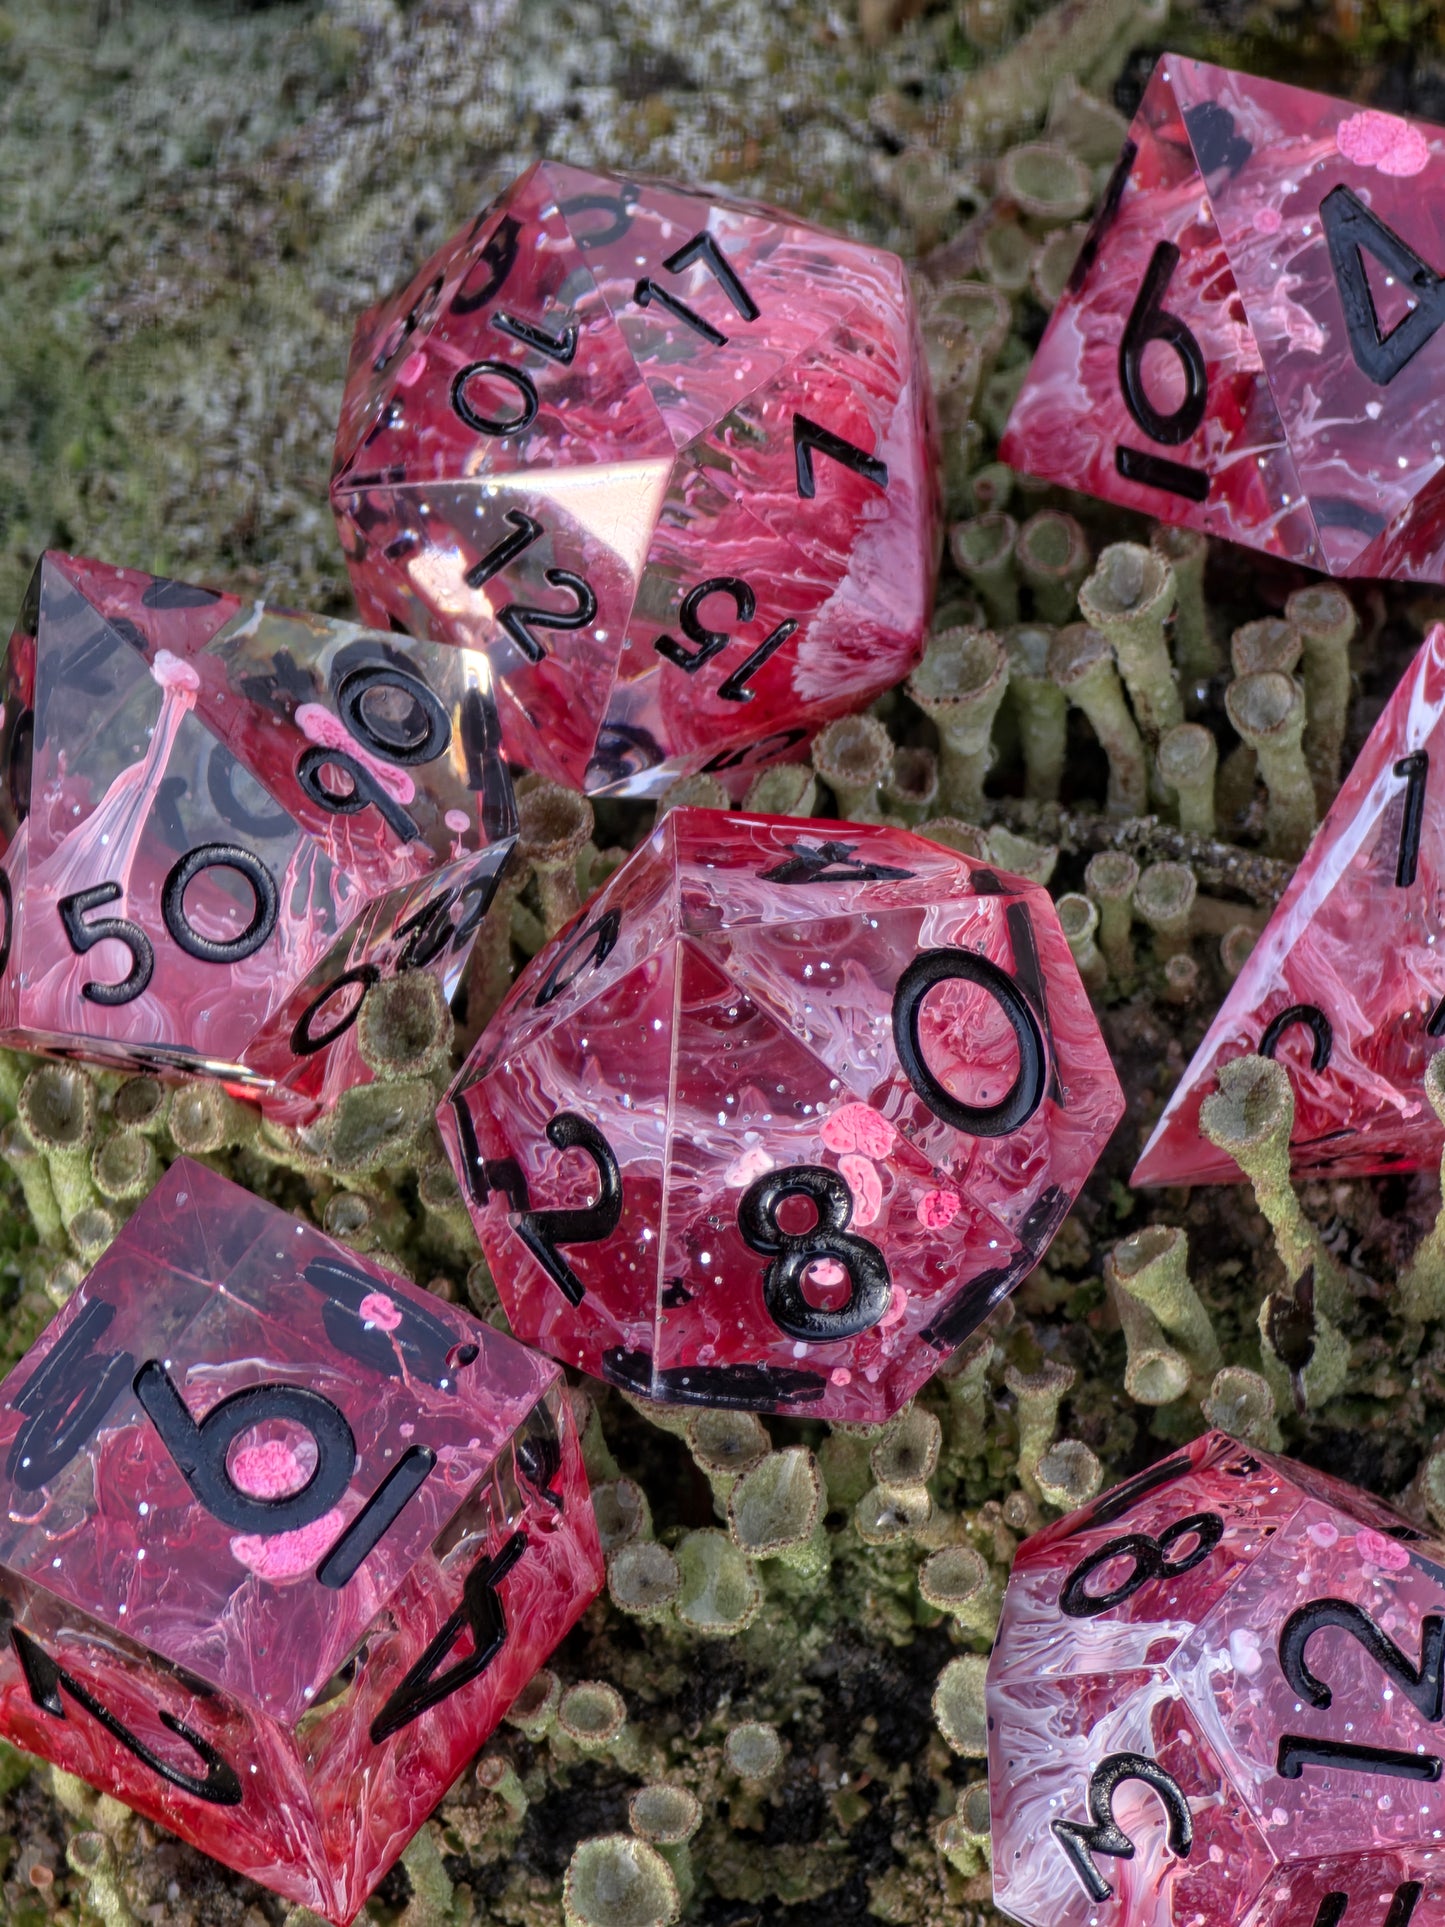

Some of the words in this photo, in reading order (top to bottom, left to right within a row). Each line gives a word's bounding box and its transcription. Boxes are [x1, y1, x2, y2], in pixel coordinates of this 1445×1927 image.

[633, 229, 761, 347] 17
[1119, 240, 1208, 446] 6
[450, 311, 579, 437] 10
[792, 411, 889, 499] 7
[464, 507, 598, 664] 12
[653, 576, 798, 702] 15
[298, 665, 454, 844] 90
[1394, 749, 1429, 888] 1
[58, 842, 281, 1006] 50
[891, 947, 1049, 1138] 0
[737, 1164, 892, 1343] 8
[369, 1531, 528, 1745] 4
[1059, 1512, 1225, 1618] 8
[1278, 1597, 1445, 1783] 12
[1049, 1752, 1194, 1903] 3
